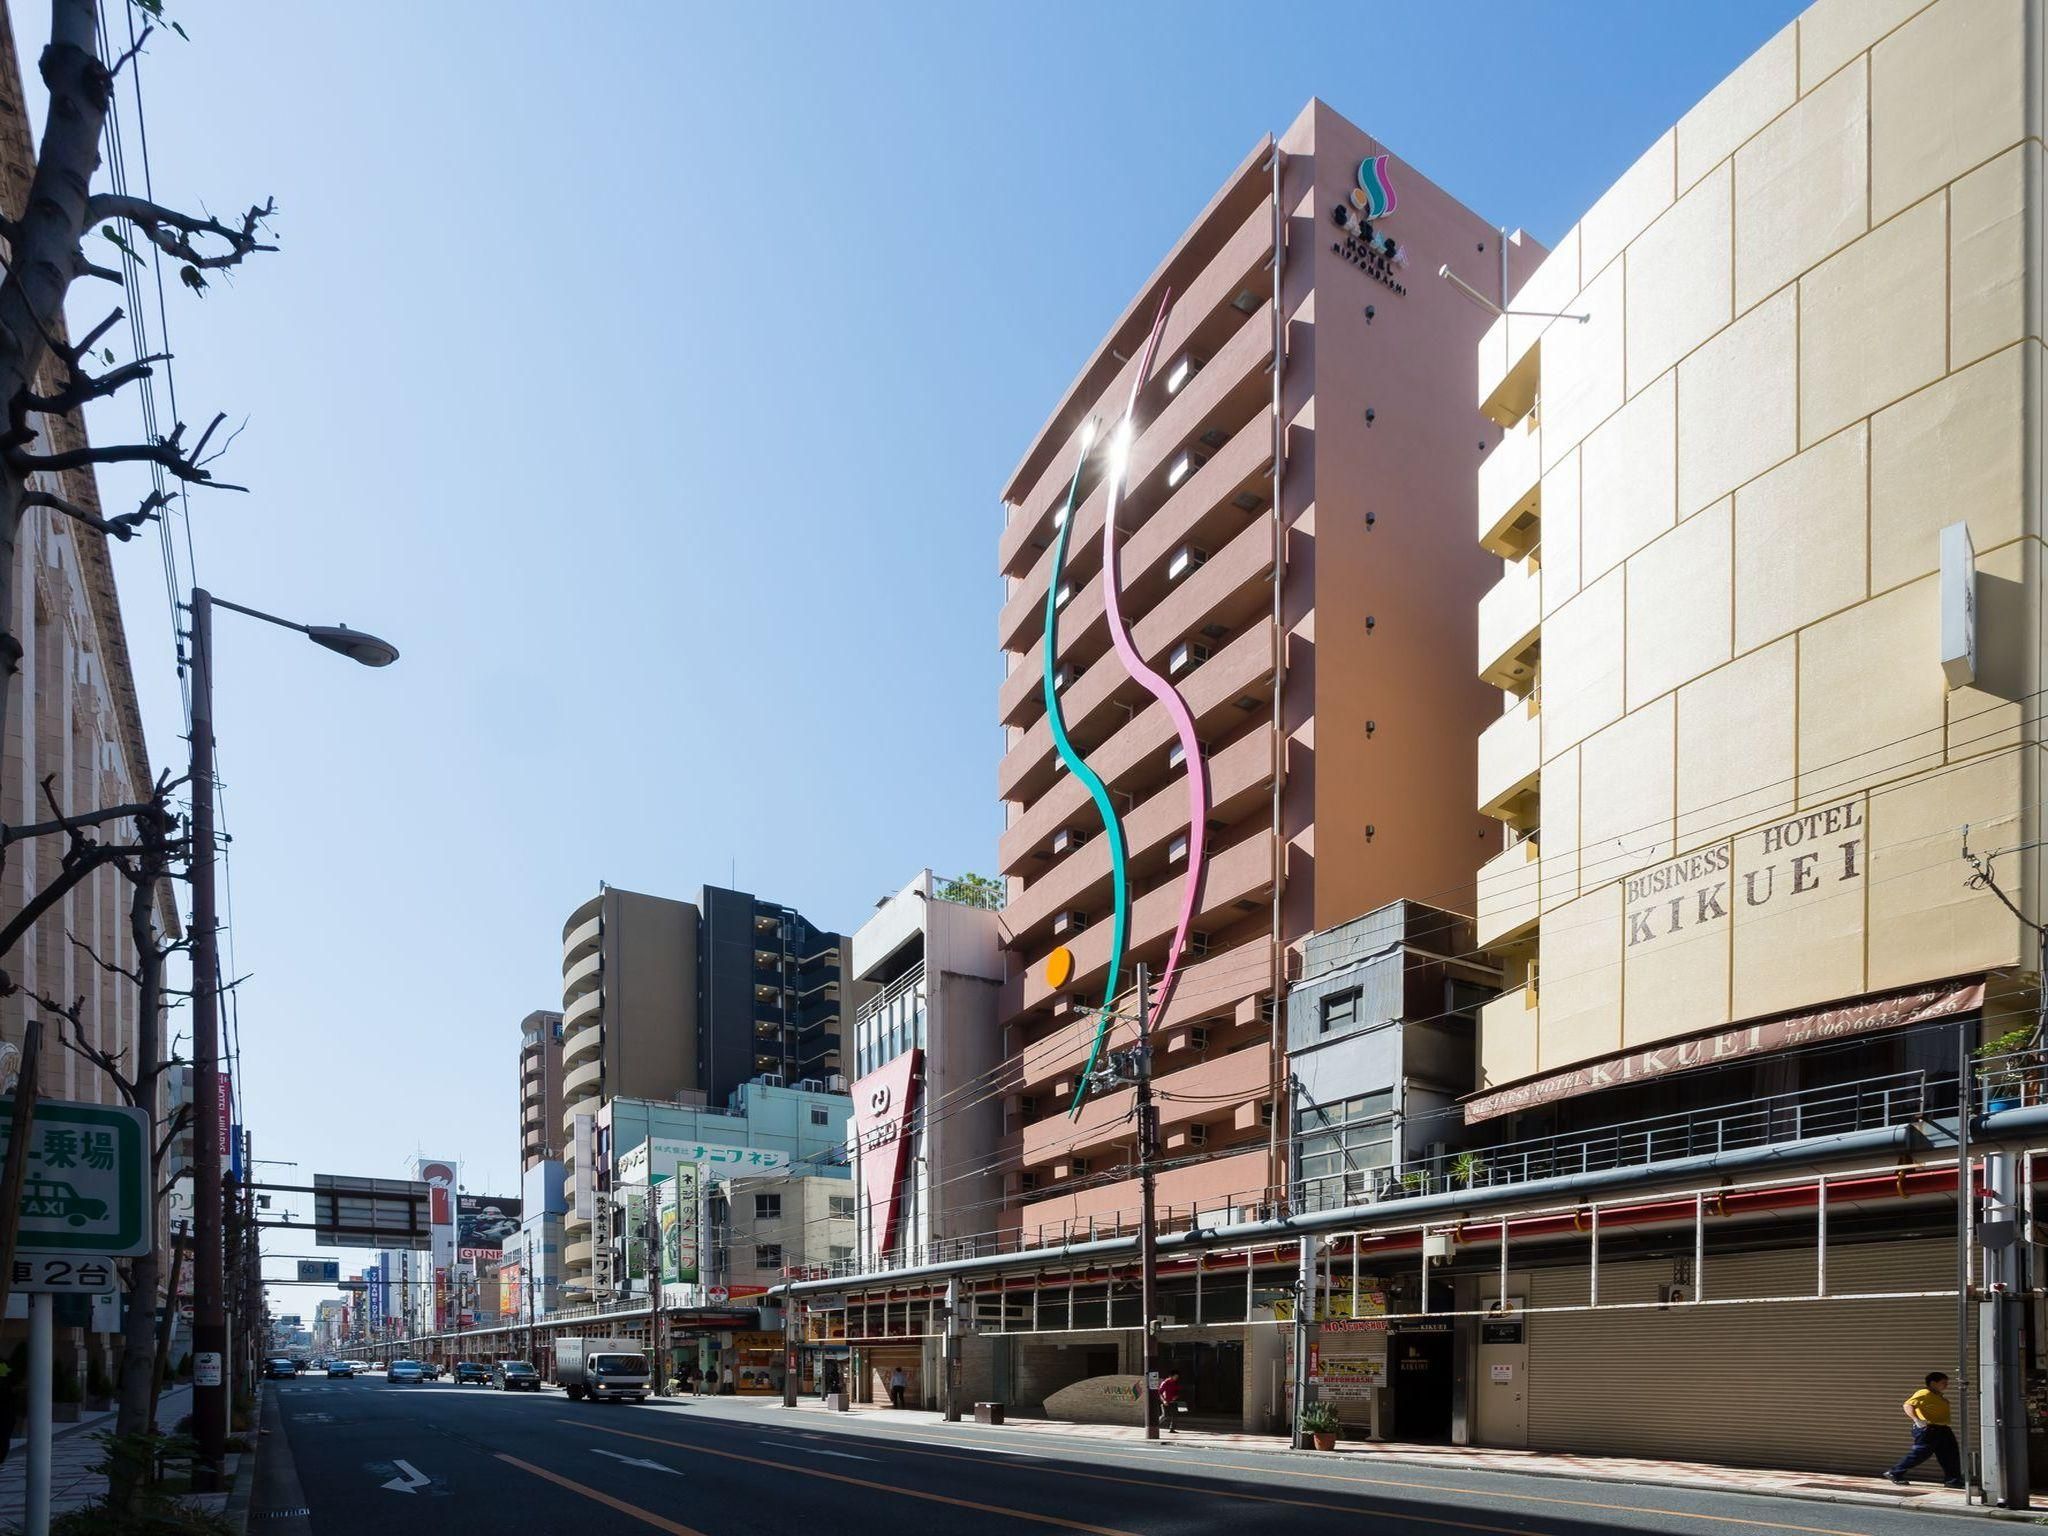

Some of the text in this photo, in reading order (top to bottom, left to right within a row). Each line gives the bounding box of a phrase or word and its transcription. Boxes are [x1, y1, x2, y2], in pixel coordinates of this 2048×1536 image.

[1347, 237, 1393, 276] HOTEL
[1627, 801, 1863, 904] BUSINESS HOTEL
[1628, 839, 1860, 947] KIKUEI
[1535, 1074, 1582, 1096] HOTEL
[1591, 1025, 1763, 1087] KIKUEI
[24, 1201, 64, 1215] AXI
